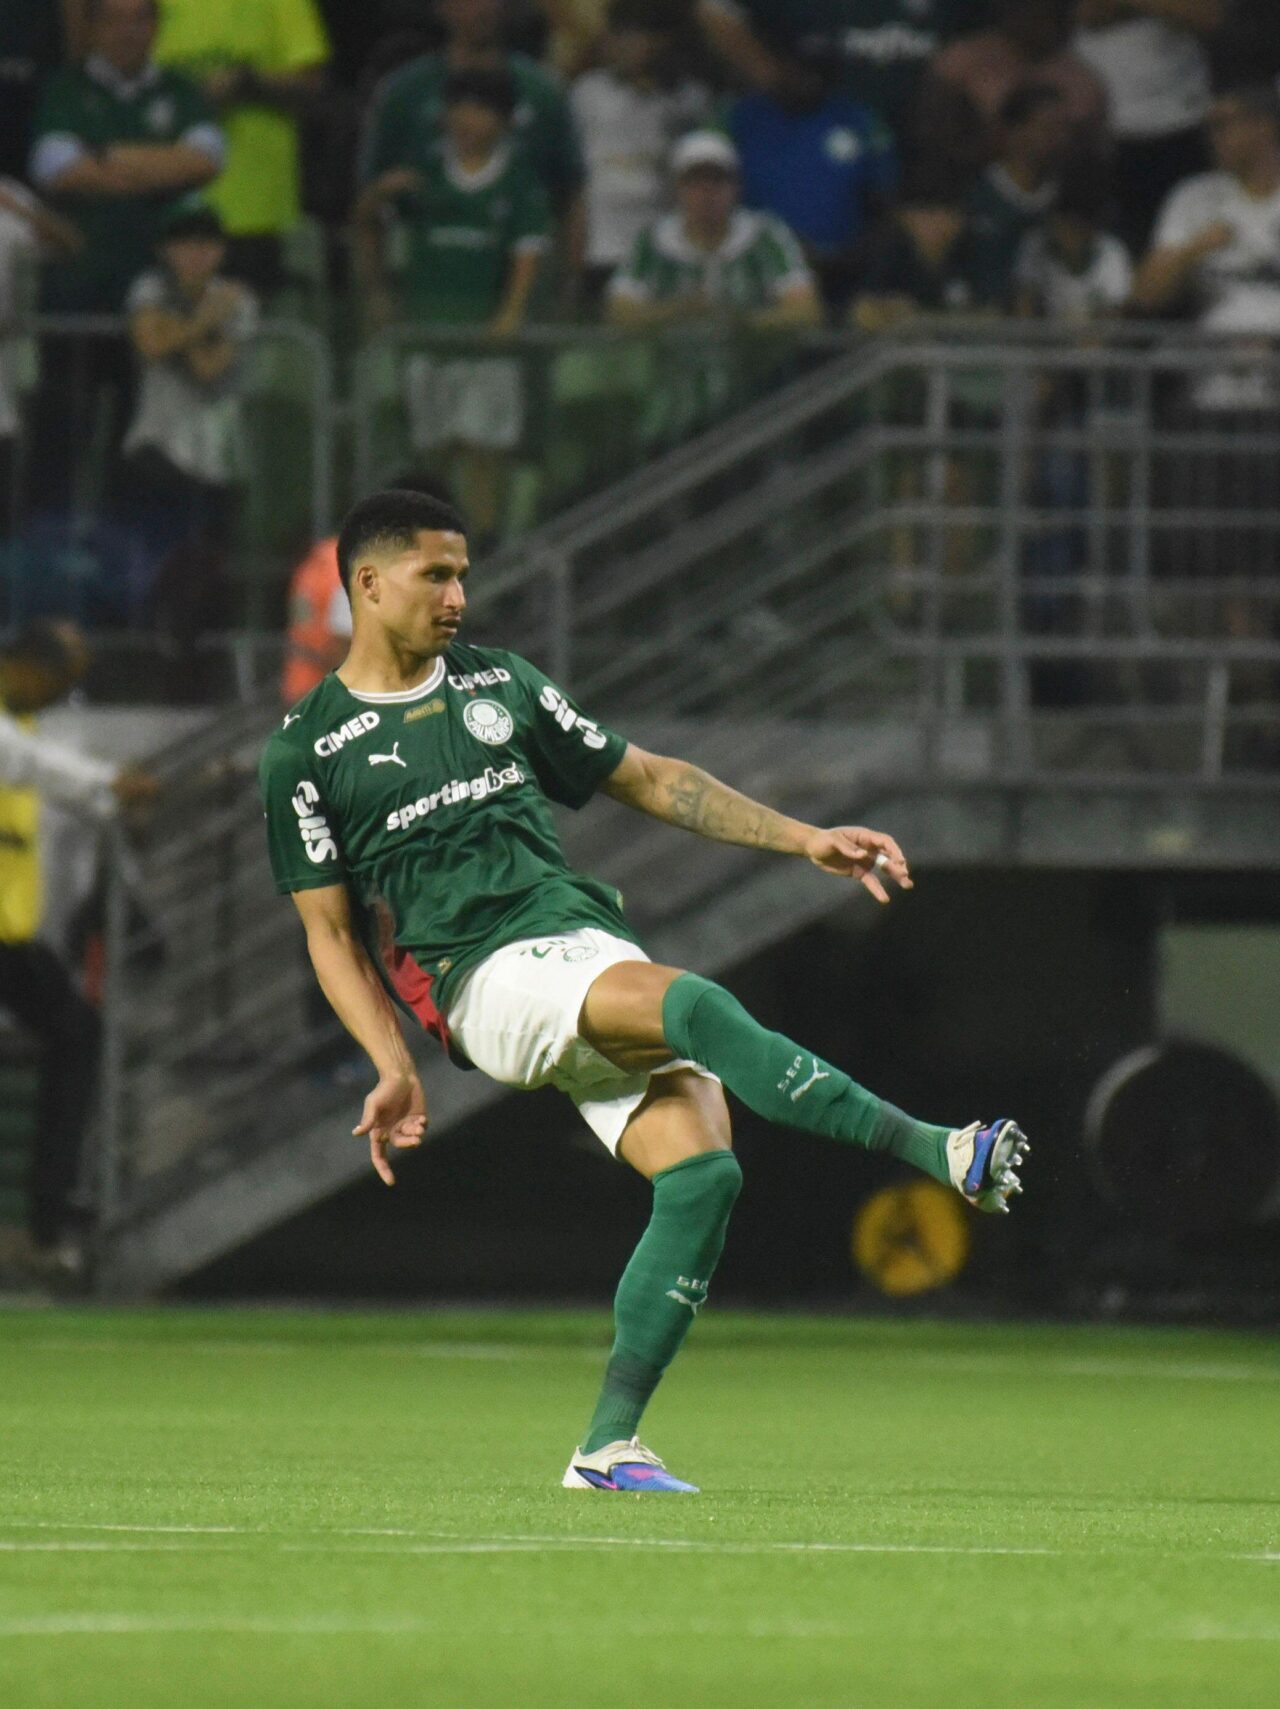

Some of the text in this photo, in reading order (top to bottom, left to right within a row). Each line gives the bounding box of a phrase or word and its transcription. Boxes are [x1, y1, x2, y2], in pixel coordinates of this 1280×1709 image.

[447, 667, 511, 691] CIMED
[313, 710, 380, 758] CIMED
[386, 761, 525, 832] sportingbet
